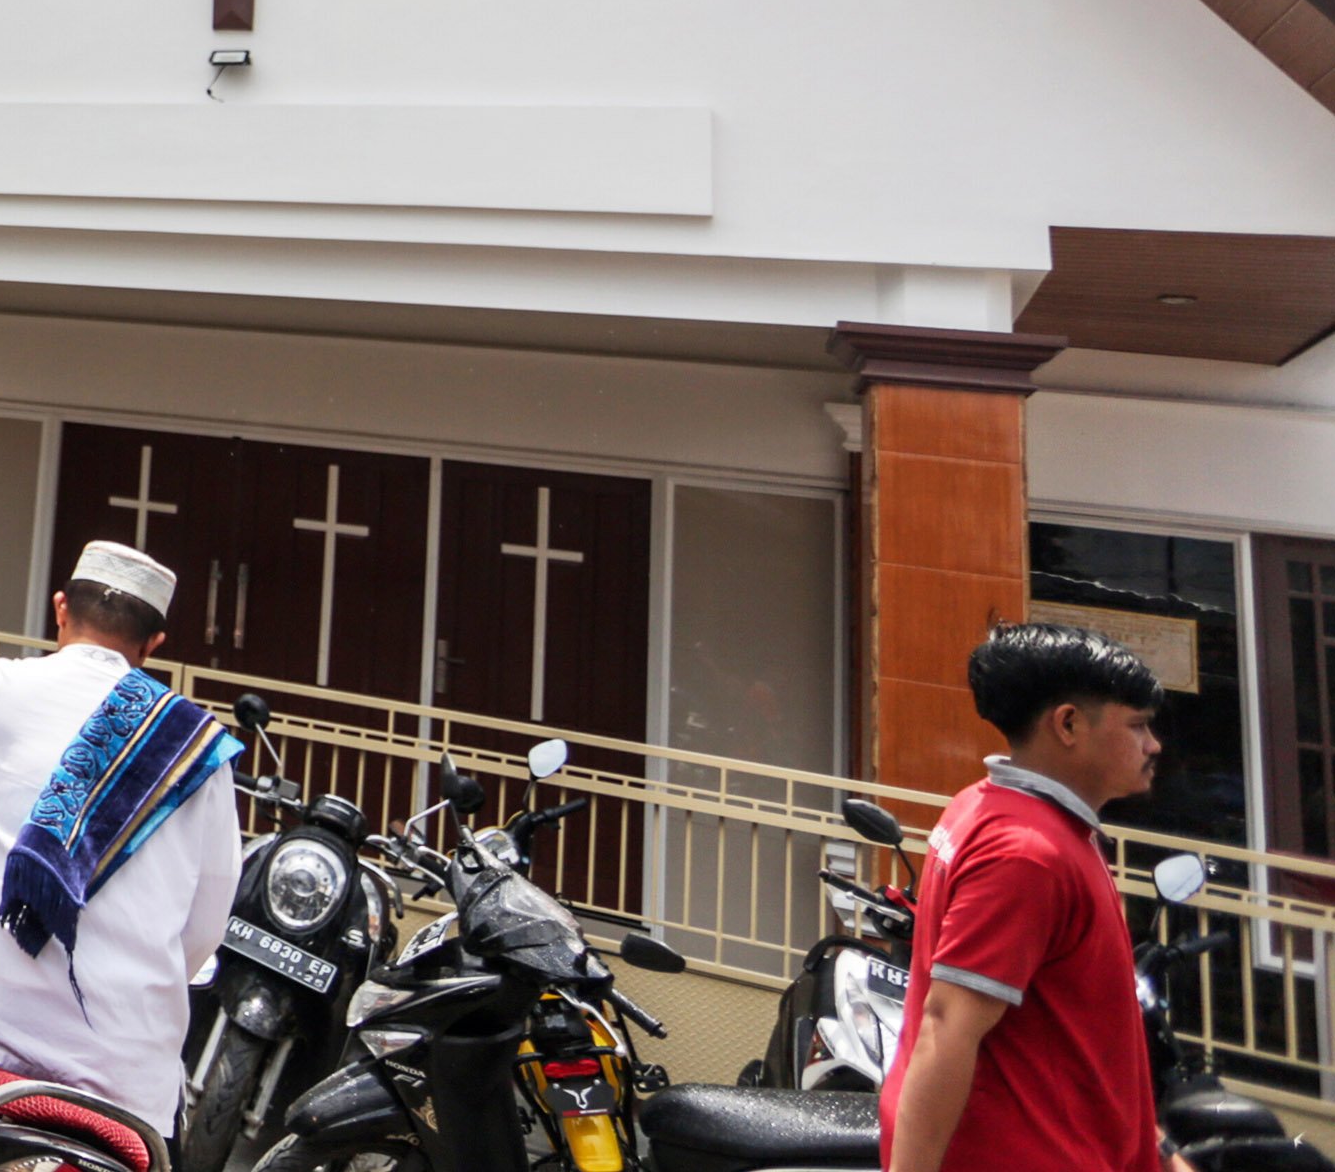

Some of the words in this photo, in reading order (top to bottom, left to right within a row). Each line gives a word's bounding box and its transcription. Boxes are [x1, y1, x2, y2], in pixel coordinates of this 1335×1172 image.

[229, 920, 254, 940] KH
[259, 936, 303, 964] 6830
[308, 959, 331, 976] EP
[384, 1058, 427, 1079] HONDA
